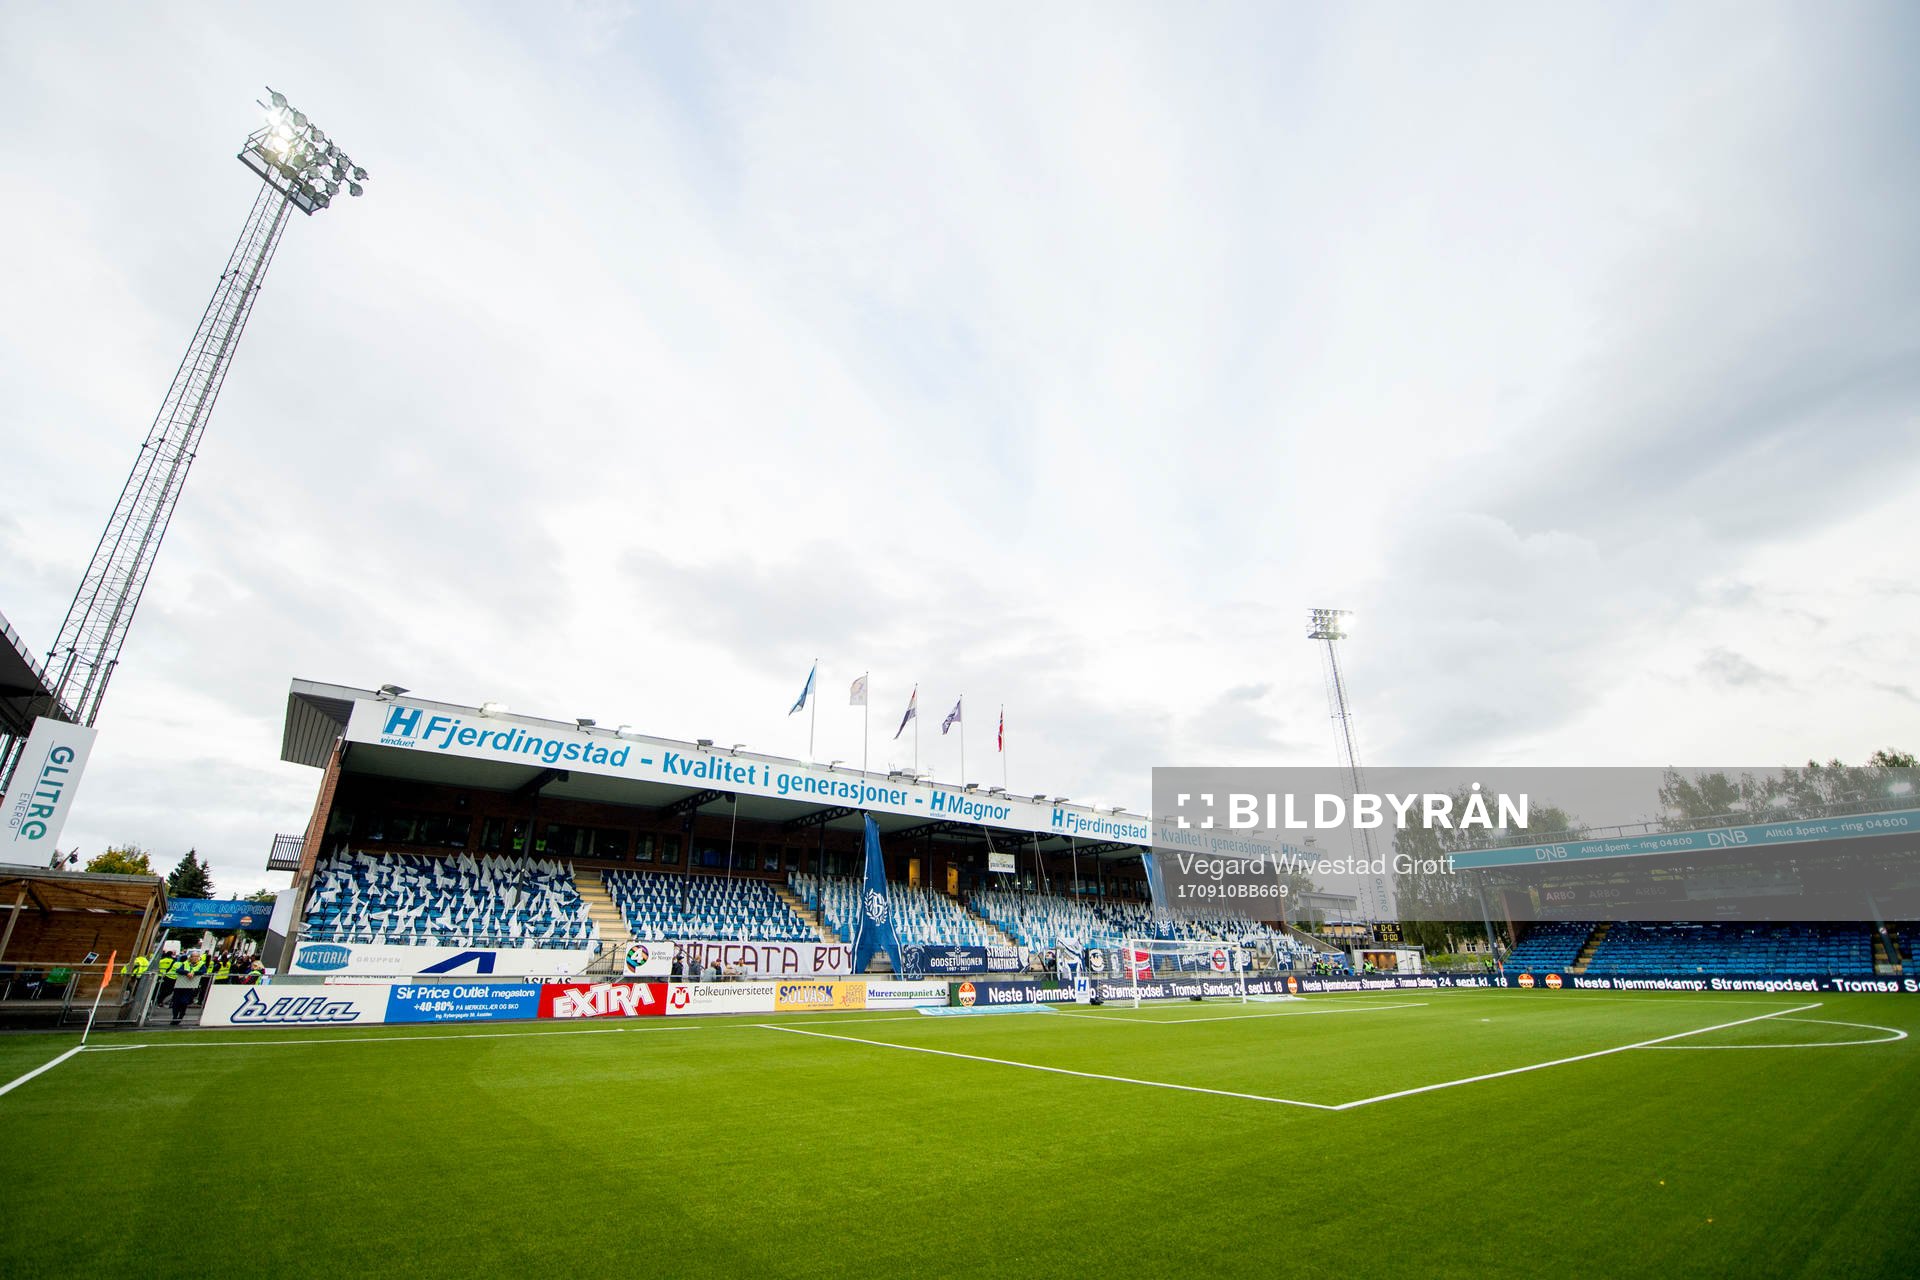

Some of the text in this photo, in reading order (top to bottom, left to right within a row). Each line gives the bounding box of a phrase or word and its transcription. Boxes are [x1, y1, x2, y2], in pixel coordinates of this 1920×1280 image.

[380, 736, 416, 748] vinduet
[422, 715, 631, 768] Fjerdingstad
[662, 751, 756, 785] Kvalitet
[763, 765, 770, 787] i
[777, 773, 908, 805] generasjoner
[948, 795, 1011, 821] Magnor
[1066, 813, 1148, 839] Fjerdingstad
[1161, 828, 1202, 847] Kvalitet
[1211, 836, 1272, 857] generasjoner
[8, 792, 31, 829] ENERGI
[1535, 845, 1568, 861] DNB
[1581, 846, 1603, 854] Alltid
[1605, 843, 1631, 853] åpent
[1640, 840, 1659, 850] ring
[1659, 837, 1693, 847] 04800
[1707, 829, 1748, 847] DNB
[1765, 828, 1793, 838] Alltid
[1796, 825, 1829, 838] åpent
[1841, 821, 1864, 832] ring
[1865, 817, 1908, 829] 04800
[300, 951, 348, 964] VICTORIA
[1077, 979, 1087, 992] H
[1438, 977, 1454, 987] 24.
[1494, 977, 1508, 988] 18
[1573, 977, 1611, 989] Neste
[1613, 977, 1708, 992] hjemmekamp:
[1711, 978, 1819, 992] Strømsgodset
[1831, 979, 1899, 992] Tromsø
[396, 986, 536, 1000] Sir Price Outlet megastore
[693, 985, 774, 997] Folkeuniversitetet
[779, 985, 834, 1005] SOLVASK
[868, 987, 946, 1000] Murercompaniet AS
[988, 987, 1023, 1003] Neste
[1203, 982, 1233, 997] Søndag
[1274, 981, 1283, 993] 18
[230, 987, 361, 1024] bilia
[553, 983, 656, 1018] EXTRA
